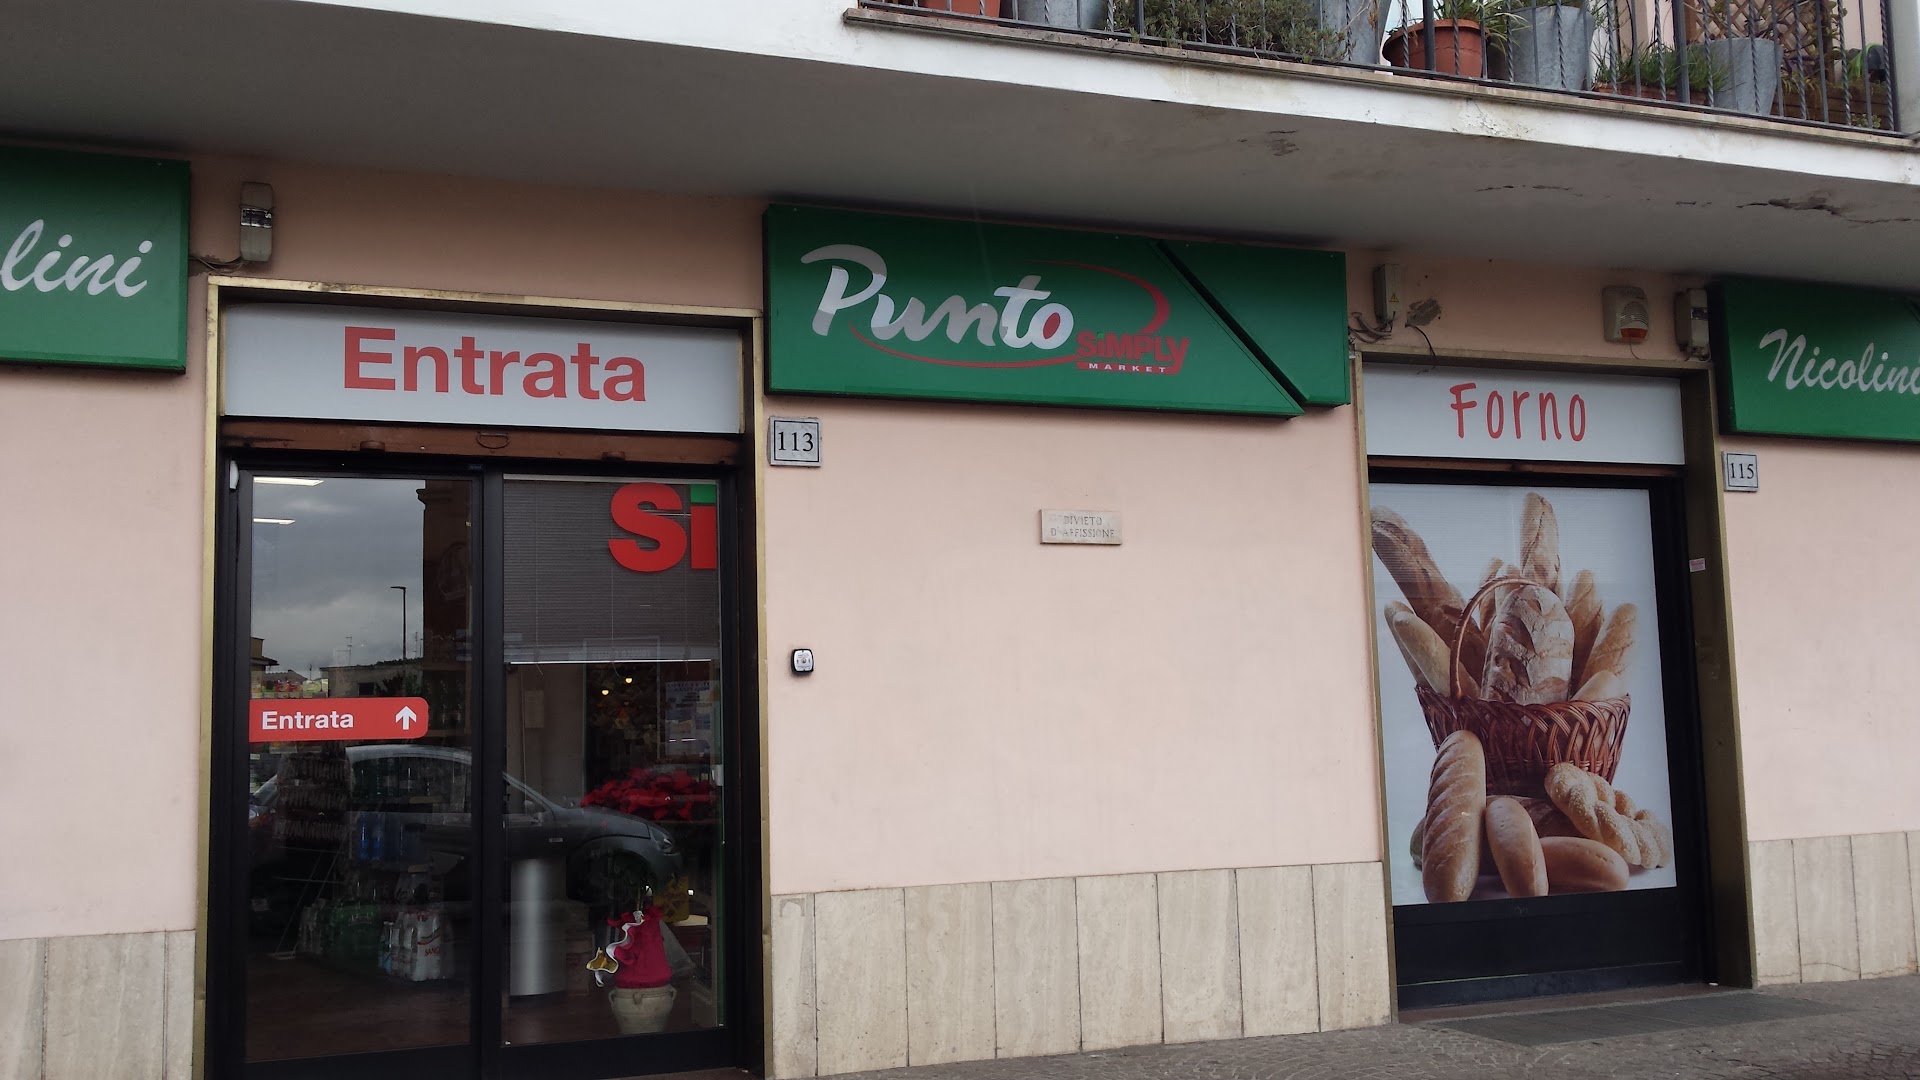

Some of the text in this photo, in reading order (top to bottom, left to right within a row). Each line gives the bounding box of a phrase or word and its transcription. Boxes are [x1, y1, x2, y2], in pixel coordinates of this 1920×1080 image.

[801, 243, 1074, 350] Punto
[344, 325, 646, 402] Entrata
[1088, 362, 1166, 373] MARKET
[1450, 382, 1586, 441] Forno
[778, 431, 814, 452] 113
[1730, 462, 1755, 480] 115
[608, 481, 717, 572] Si
[262, 710, 354, 730] Entrata
